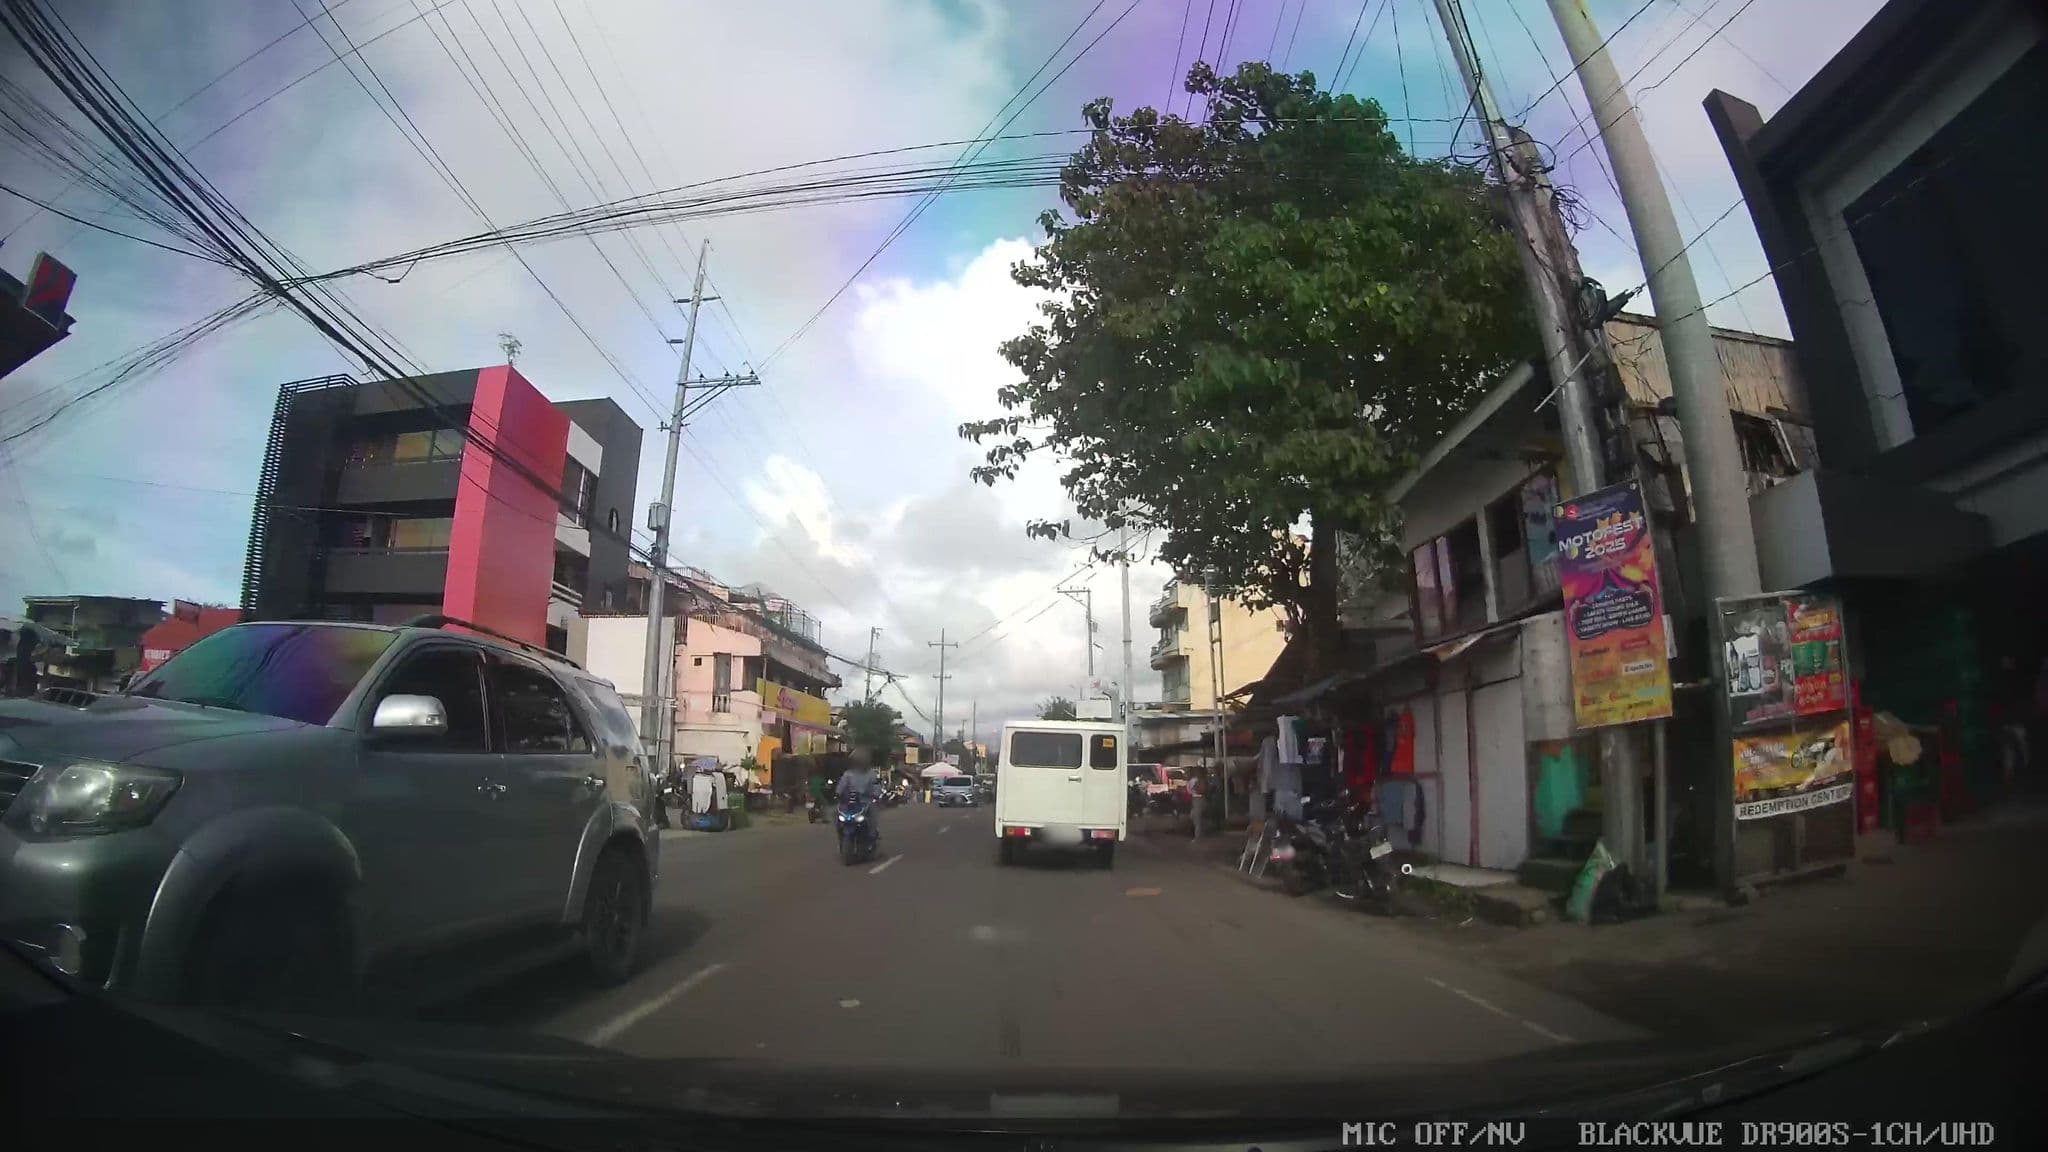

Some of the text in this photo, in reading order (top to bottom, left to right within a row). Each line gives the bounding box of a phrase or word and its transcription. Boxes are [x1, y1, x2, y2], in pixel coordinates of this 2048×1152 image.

[1559, 516, 1643, 552] MOTOFEST
[1584, 538, 1626, 559] 2025
[1740, 787, 1849, 817] REDEMPTION CENTER
